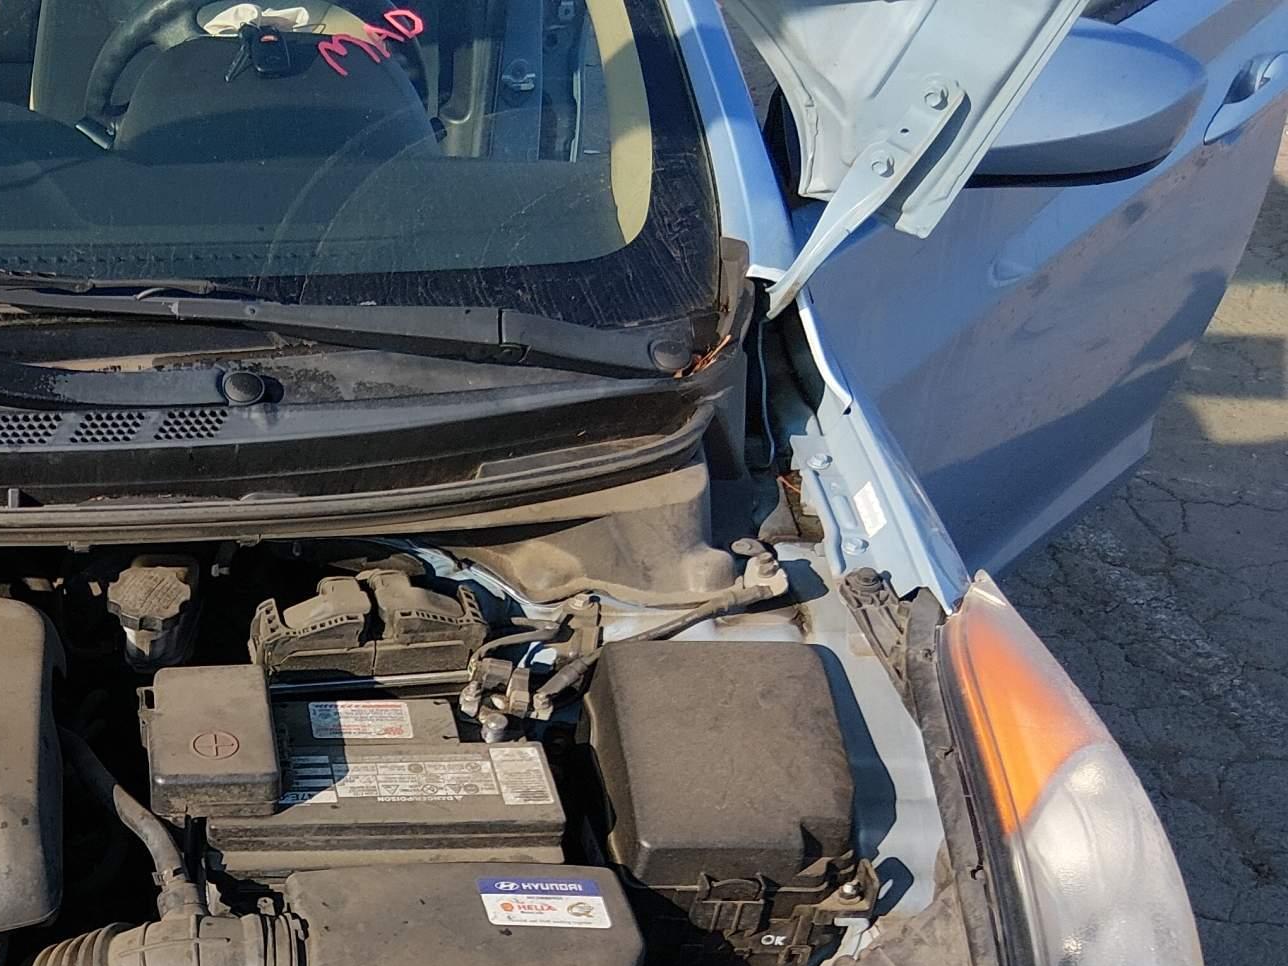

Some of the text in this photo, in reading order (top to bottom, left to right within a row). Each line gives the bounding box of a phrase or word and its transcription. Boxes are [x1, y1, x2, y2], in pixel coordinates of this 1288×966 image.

[318, 9, 424, 77] MAD
[521, 882, 584, 892] HYUNDAI
[516, 903, 558, 913] HELIX
[760, 934, 787, 946] OK
